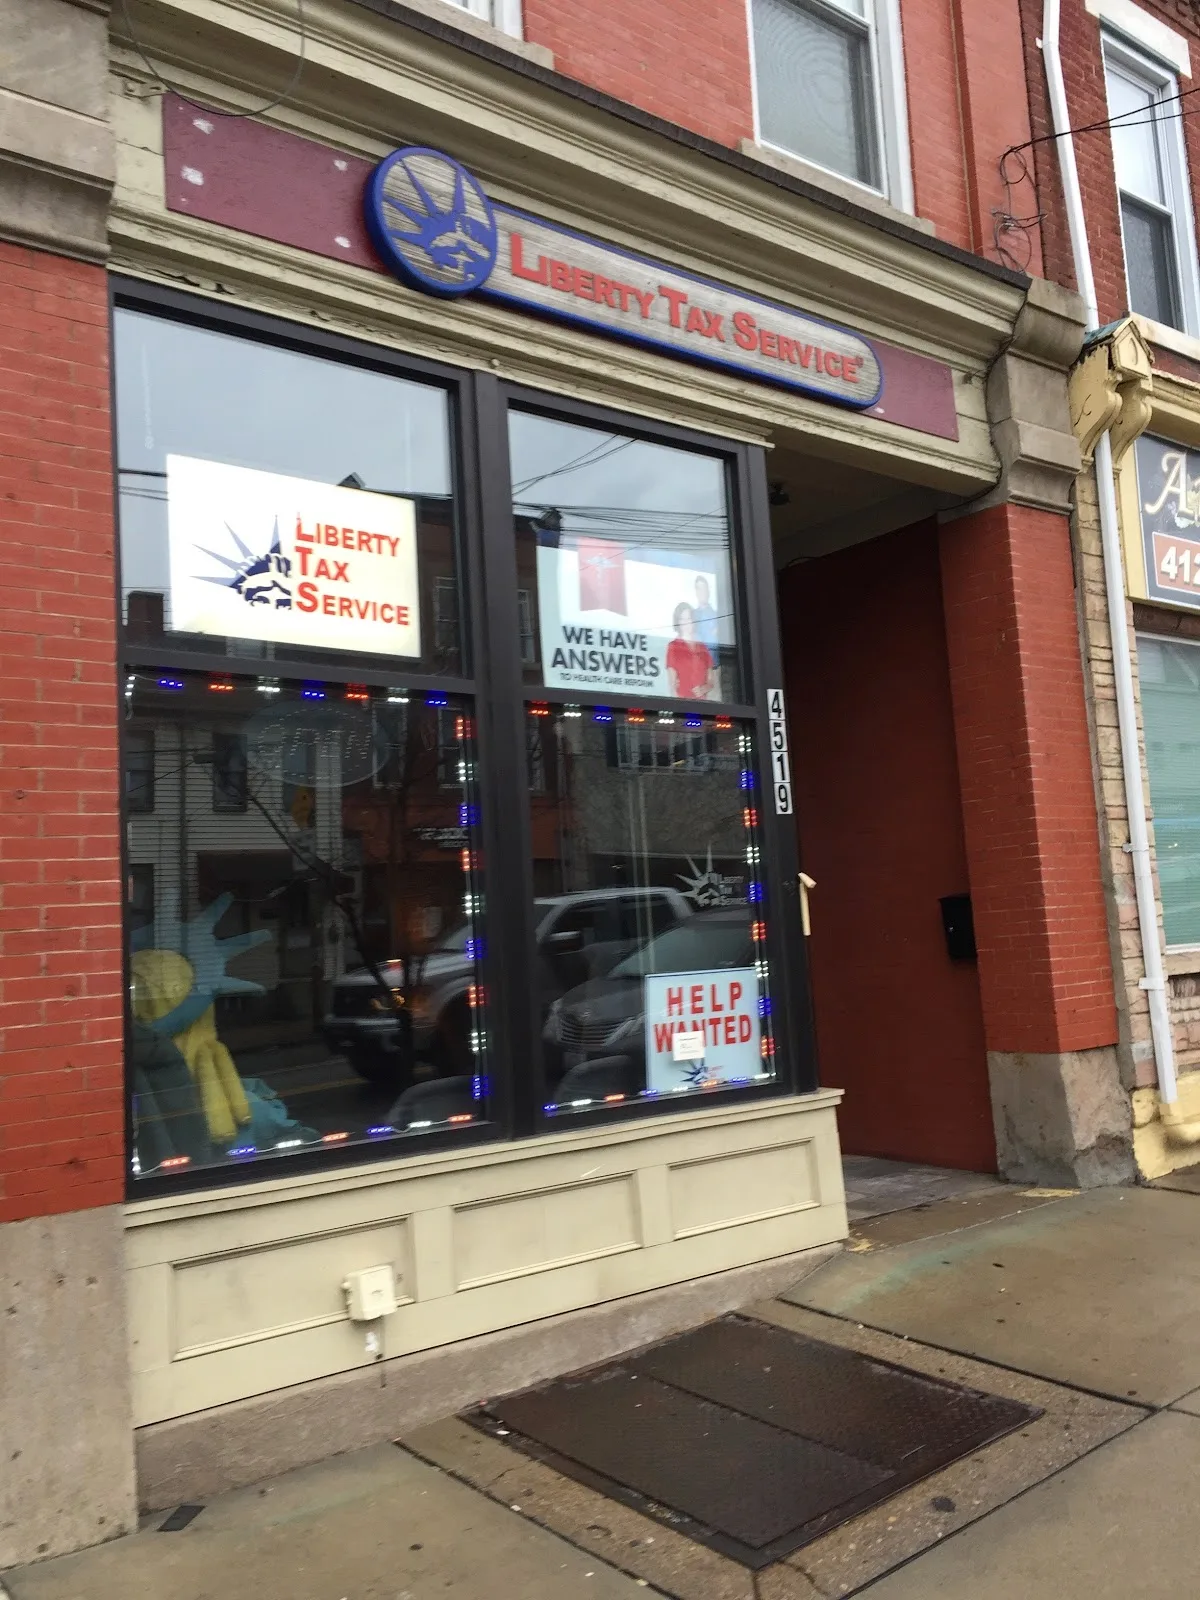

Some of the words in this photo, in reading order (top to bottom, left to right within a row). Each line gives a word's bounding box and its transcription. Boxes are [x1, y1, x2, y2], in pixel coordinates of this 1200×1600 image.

[510, 232, 655, 319] LIBERTY
[658, 285, 725, 342] TAX
[295, 512, 401, 557] LIBERTY
[294, 546, 350, 583] TAX
[296, 581, 410, 626] SERVICE
[563, 625, 593, 645] WE
[599, 630, 648, 651] HAVE
[551, 648, 660, 677] ANSWERS
[560, 672, 571, 681] TO
[770, 691, 789, 813] 4519
[666, 981, 743, 1017] HELP
